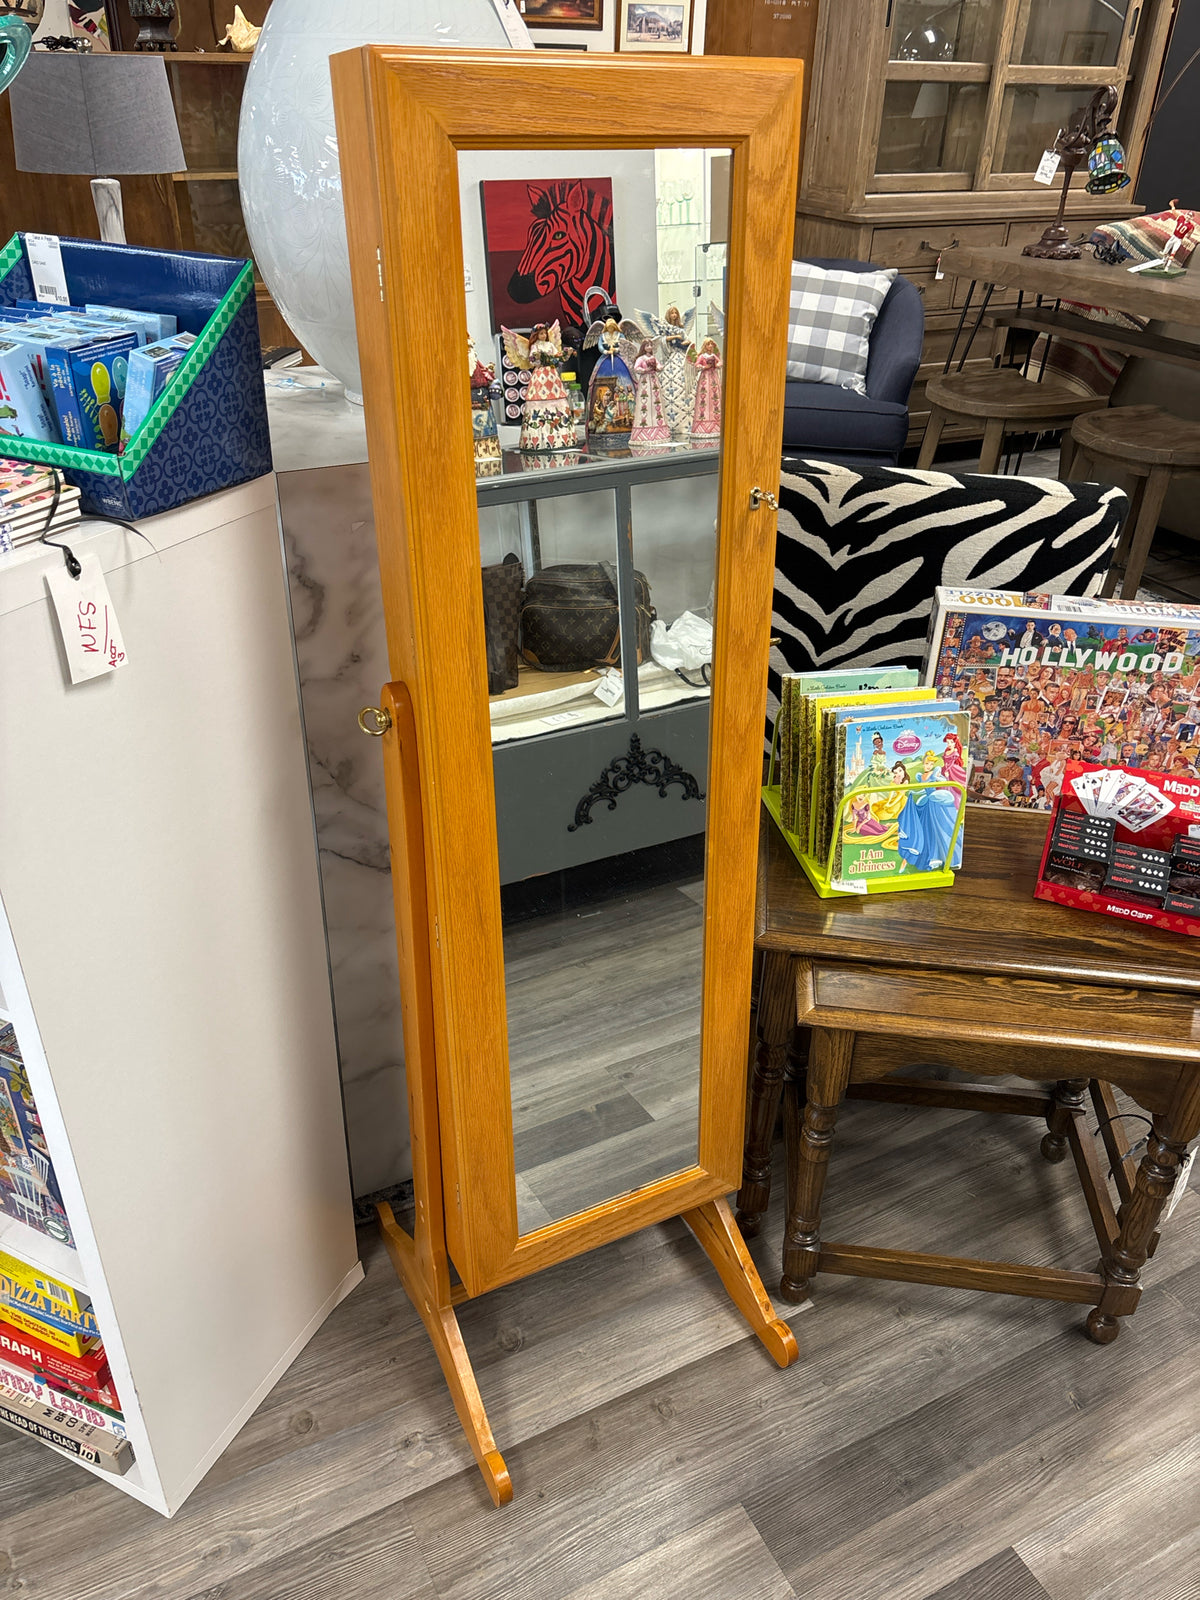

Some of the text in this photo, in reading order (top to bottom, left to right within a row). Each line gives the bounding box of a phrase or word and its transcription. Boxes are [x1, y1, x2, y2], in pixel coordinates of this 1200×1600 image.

[1176, 222, 1188, 234] 10
[959, 594, 1026, 608] 1000
[1000, 646, 1184, 673] HOLLYWOOD
[896, 739, 919, 750] Disney
[861, 850, 884, 860] I Am
[849, 860, 896, 875] a Princess
[1052, 856, 1084, 869] WOLF
[1176, 862, 1200, 872] OW
[50, 1392, 105, 1428] LAND
[9, 1413, 28, 1428] HEAD
[29, 1422, 37, 1432] OF
[39, 1427, 52, 1439] THE
[52, 1432, 78, 1452] CLASS
[80, 1450, 94, 1461] 10
